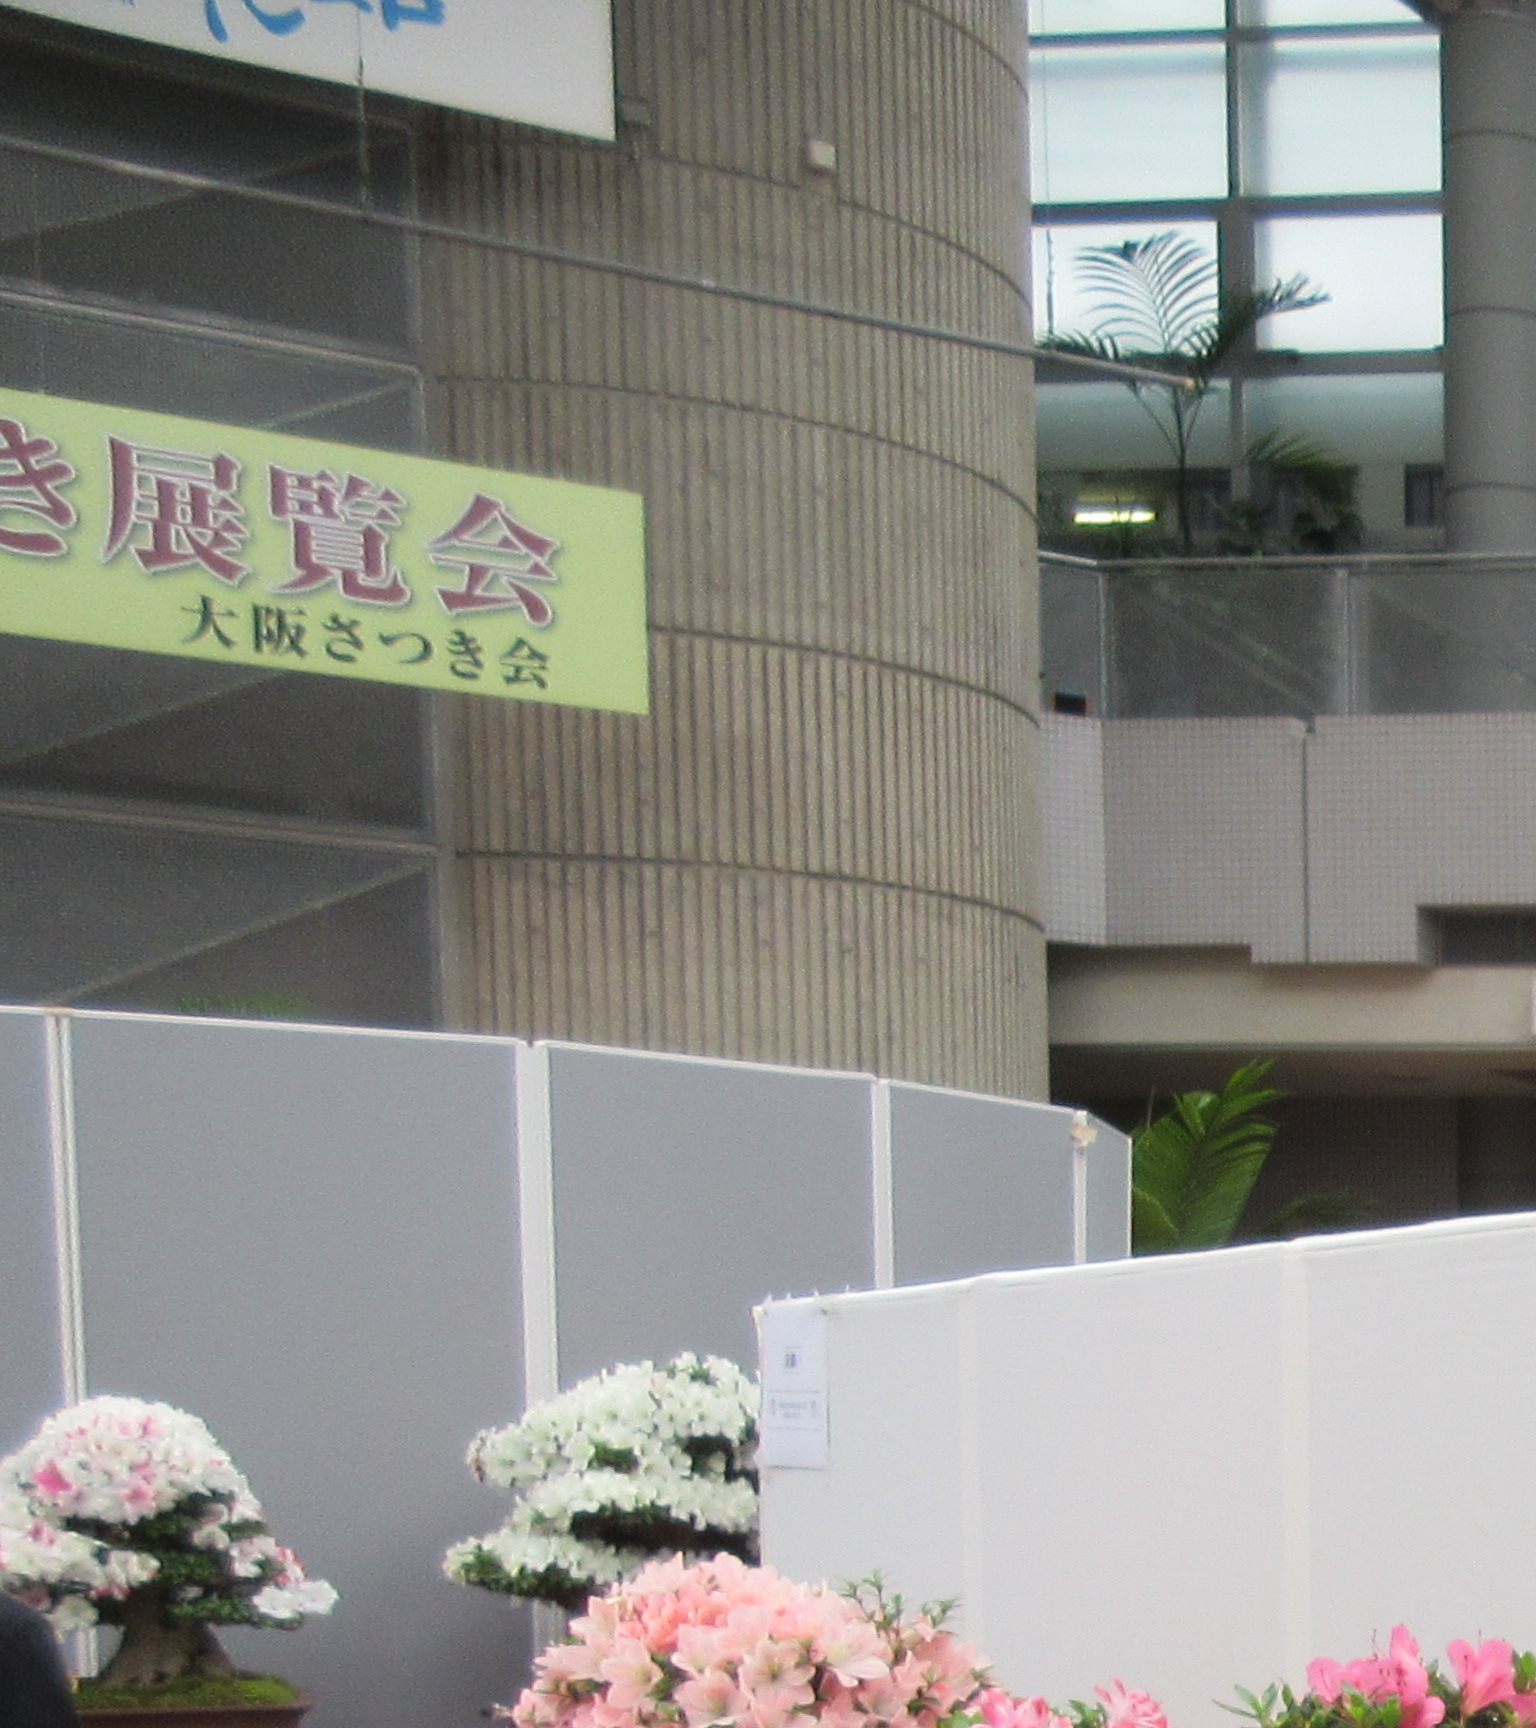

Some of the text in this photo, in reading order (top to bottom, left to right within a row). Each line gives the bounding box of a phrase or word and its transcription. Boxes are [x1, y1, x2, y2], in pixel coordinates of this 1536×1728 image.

[181, 595, 549, 689] 大阪さつき会
